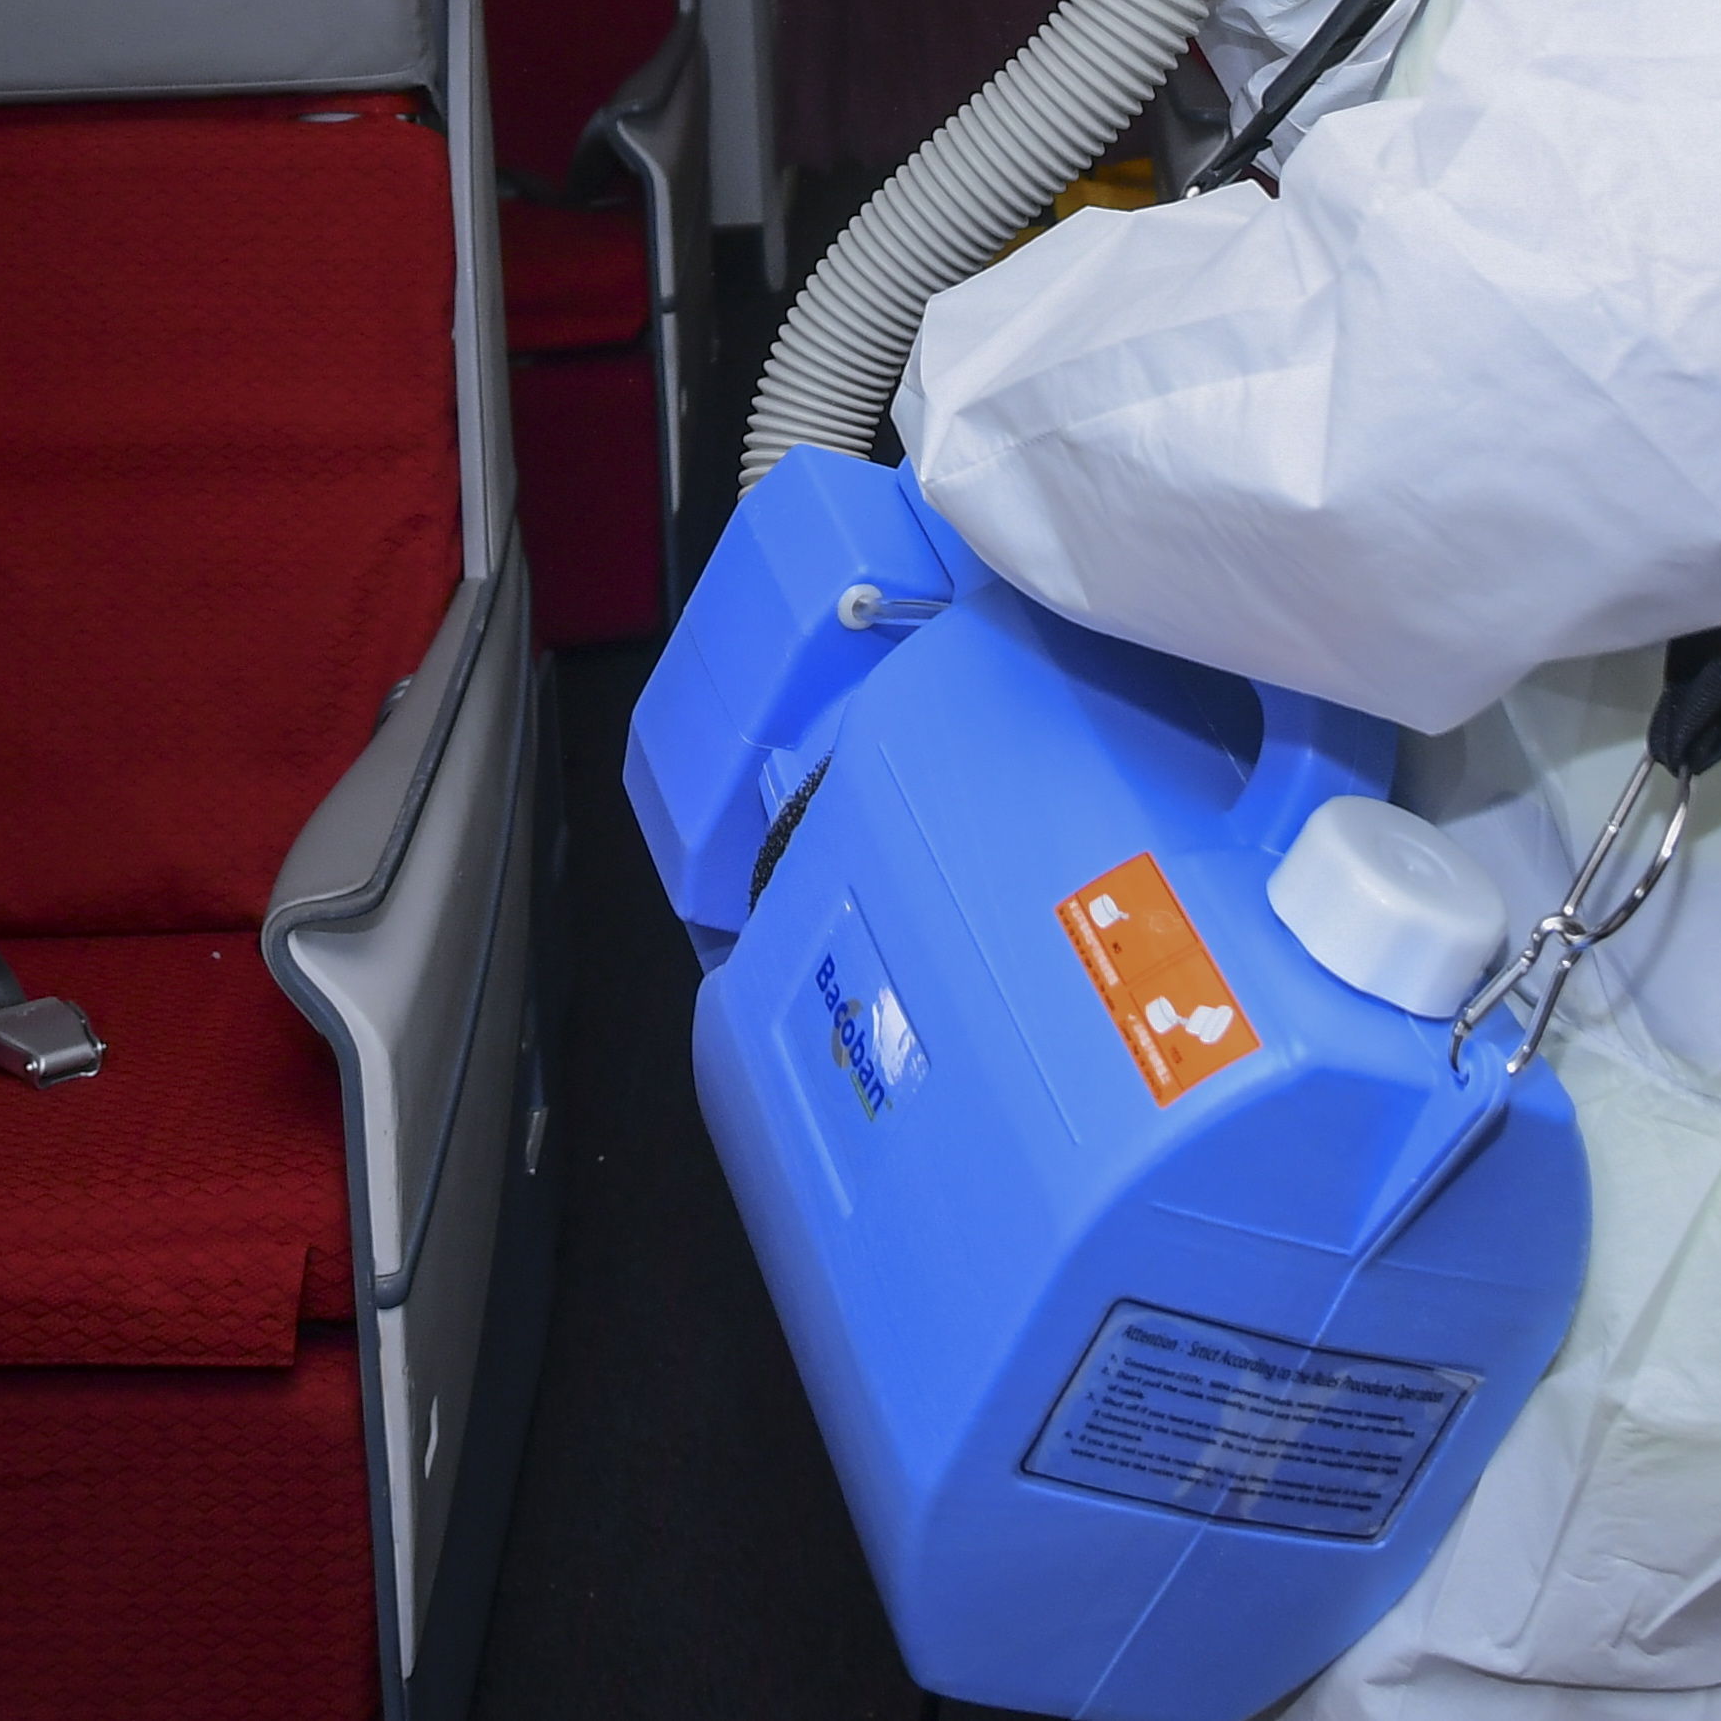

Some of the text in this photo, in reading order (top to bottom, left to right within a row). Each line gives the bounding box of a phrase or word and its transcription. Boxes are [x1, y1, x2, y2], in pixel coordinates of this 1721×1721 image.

[814, 951, 885, 1114] Bacoban
[1123, 1323, 1178, 1351] Attention
[1220, 1348, 1276, 1381] According
